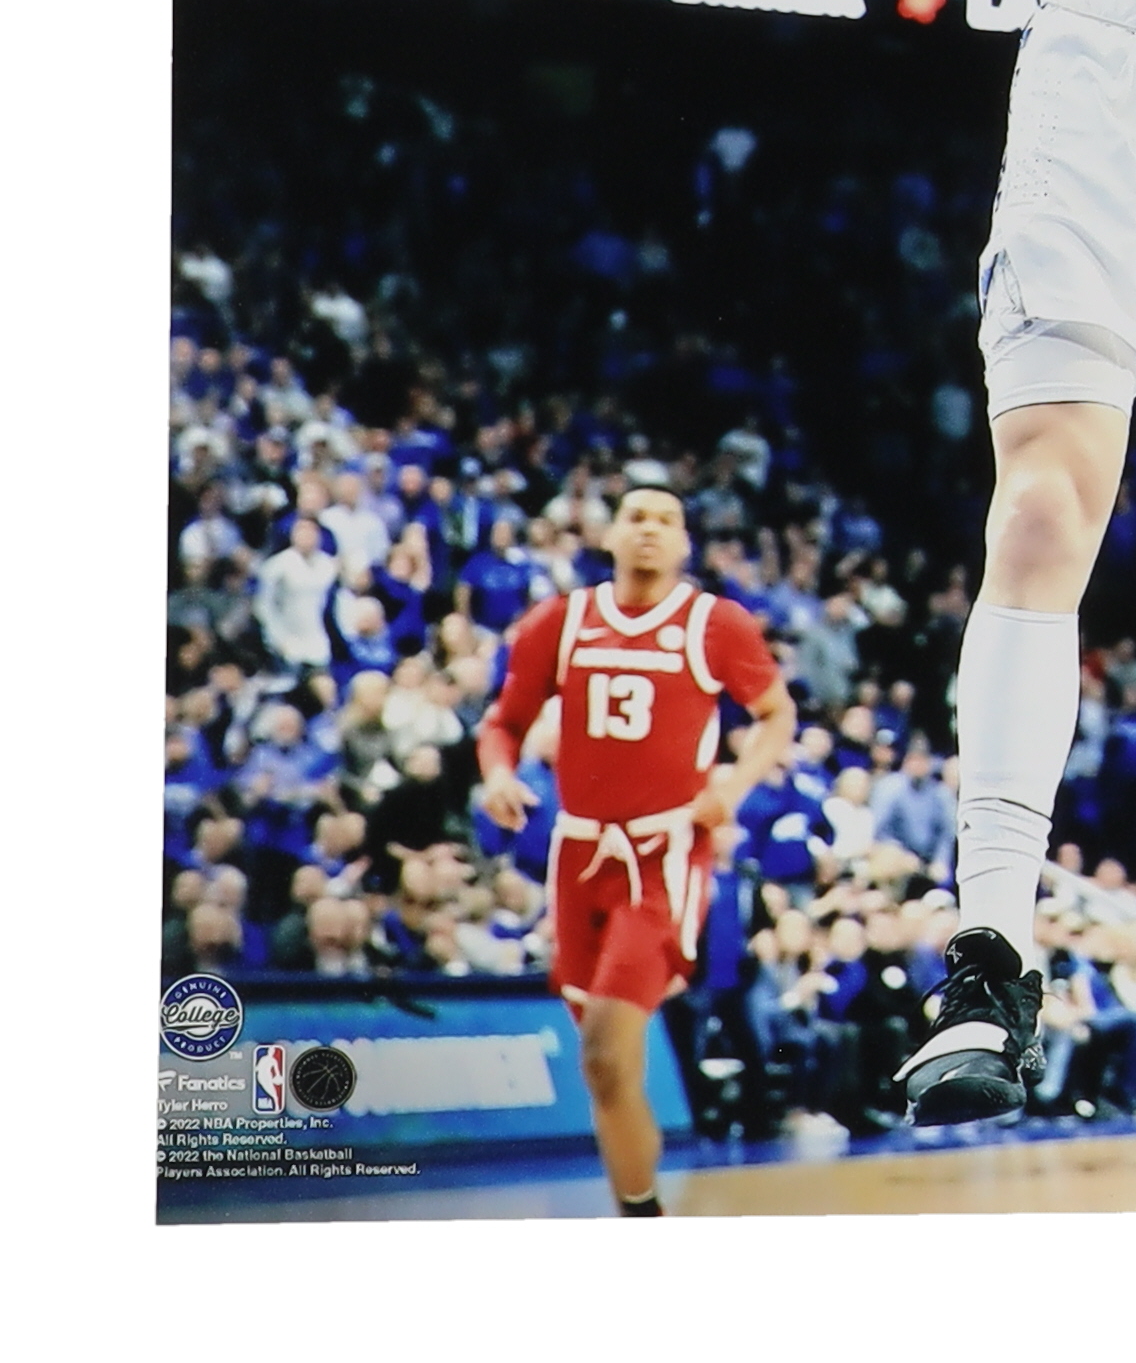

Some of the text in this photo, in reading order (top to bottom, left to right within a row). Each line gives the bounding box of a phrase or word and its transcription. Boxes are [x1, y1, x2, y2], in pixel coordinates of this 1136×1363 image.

[587, 672, 655, 742] 13
[161, 1002, 240, 1029] College
[178, 1074, 246, 1091] Fanatics
[158, 1099, 228, 1114] Tyler Herro
[169, 1119, 200, 1130] 2022
[203, 1118, 233, 1129] NBA
[236, 1117, 307, 1131] Properties,
[310, 1116, 334, 1128] Inc.
[158, 1133, 287, 1148] All Rights Reserved.
[169, 1150, 199, 1162] 2022
[203, 1149, 223, 1161] the
[227, 1149, 281, 1161] National
[284, 1148, 352, 1160] Basketball
[156, 1163, 420, 1180] Players Association. All Rights Reserved.
